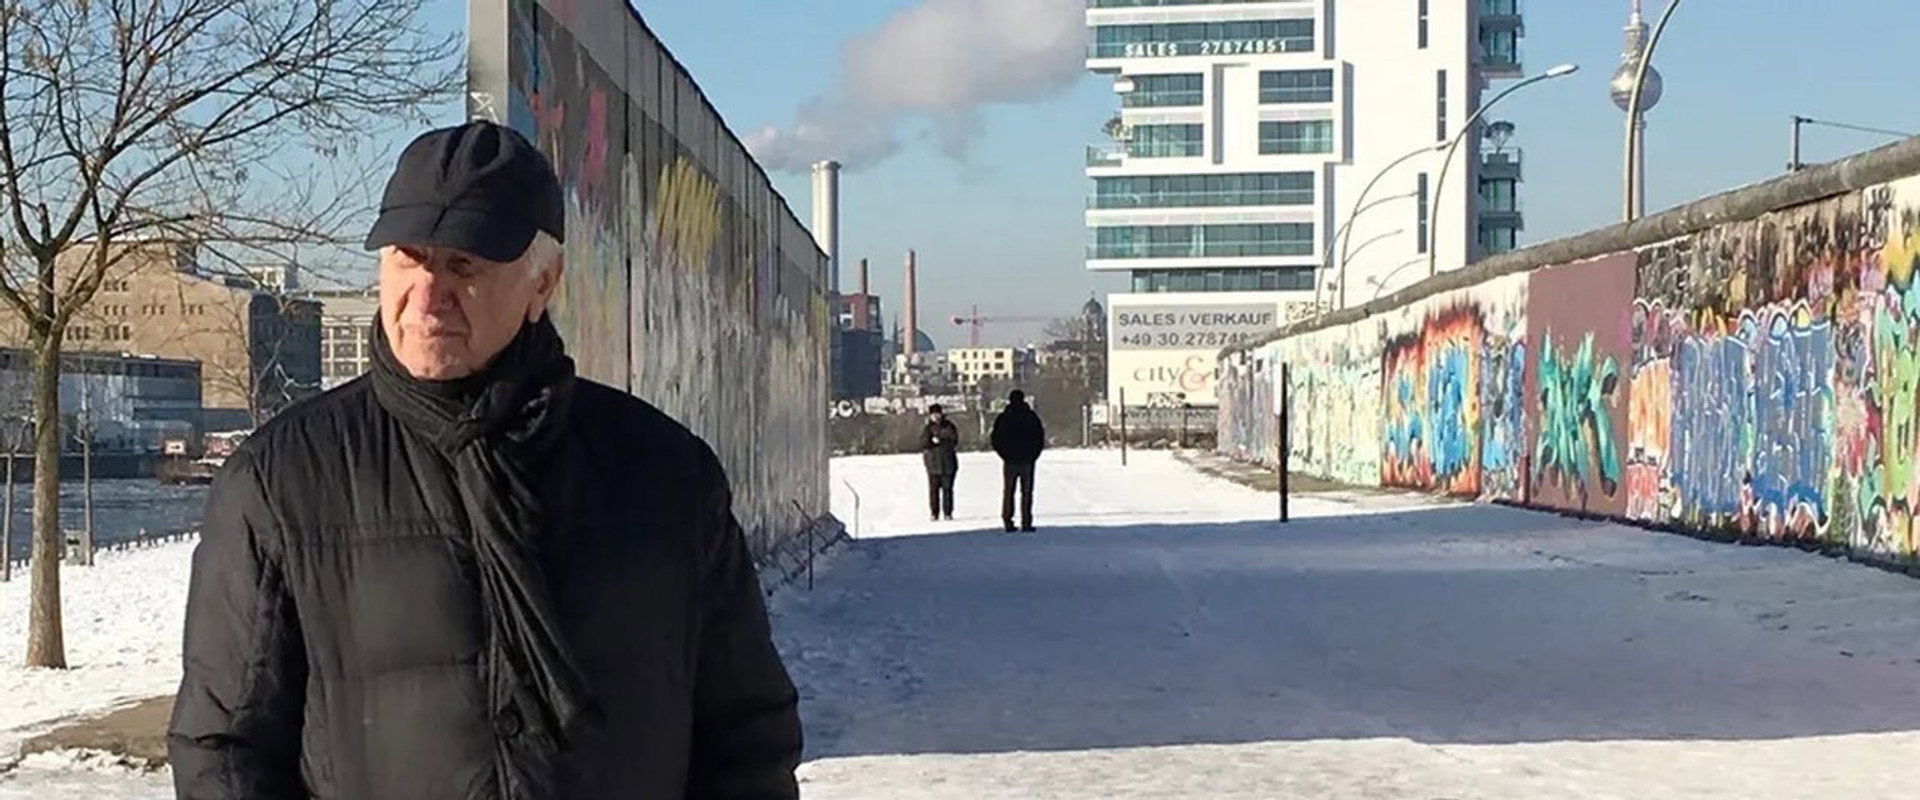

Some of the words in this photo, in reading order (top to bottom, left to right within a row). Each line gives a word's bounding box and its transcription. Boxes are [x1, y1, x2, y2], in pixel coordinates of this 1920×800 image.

[1125, 42, 1178, 57] SALES
[1200, 39, 1287, 55] 27874851
[1118, 312, 1176, 326] SALES
[1179, 312, 1185, 325] /
[1189, 311, 1272, 326] VERKAUF
[1120, 332, 1151, 346] +49
